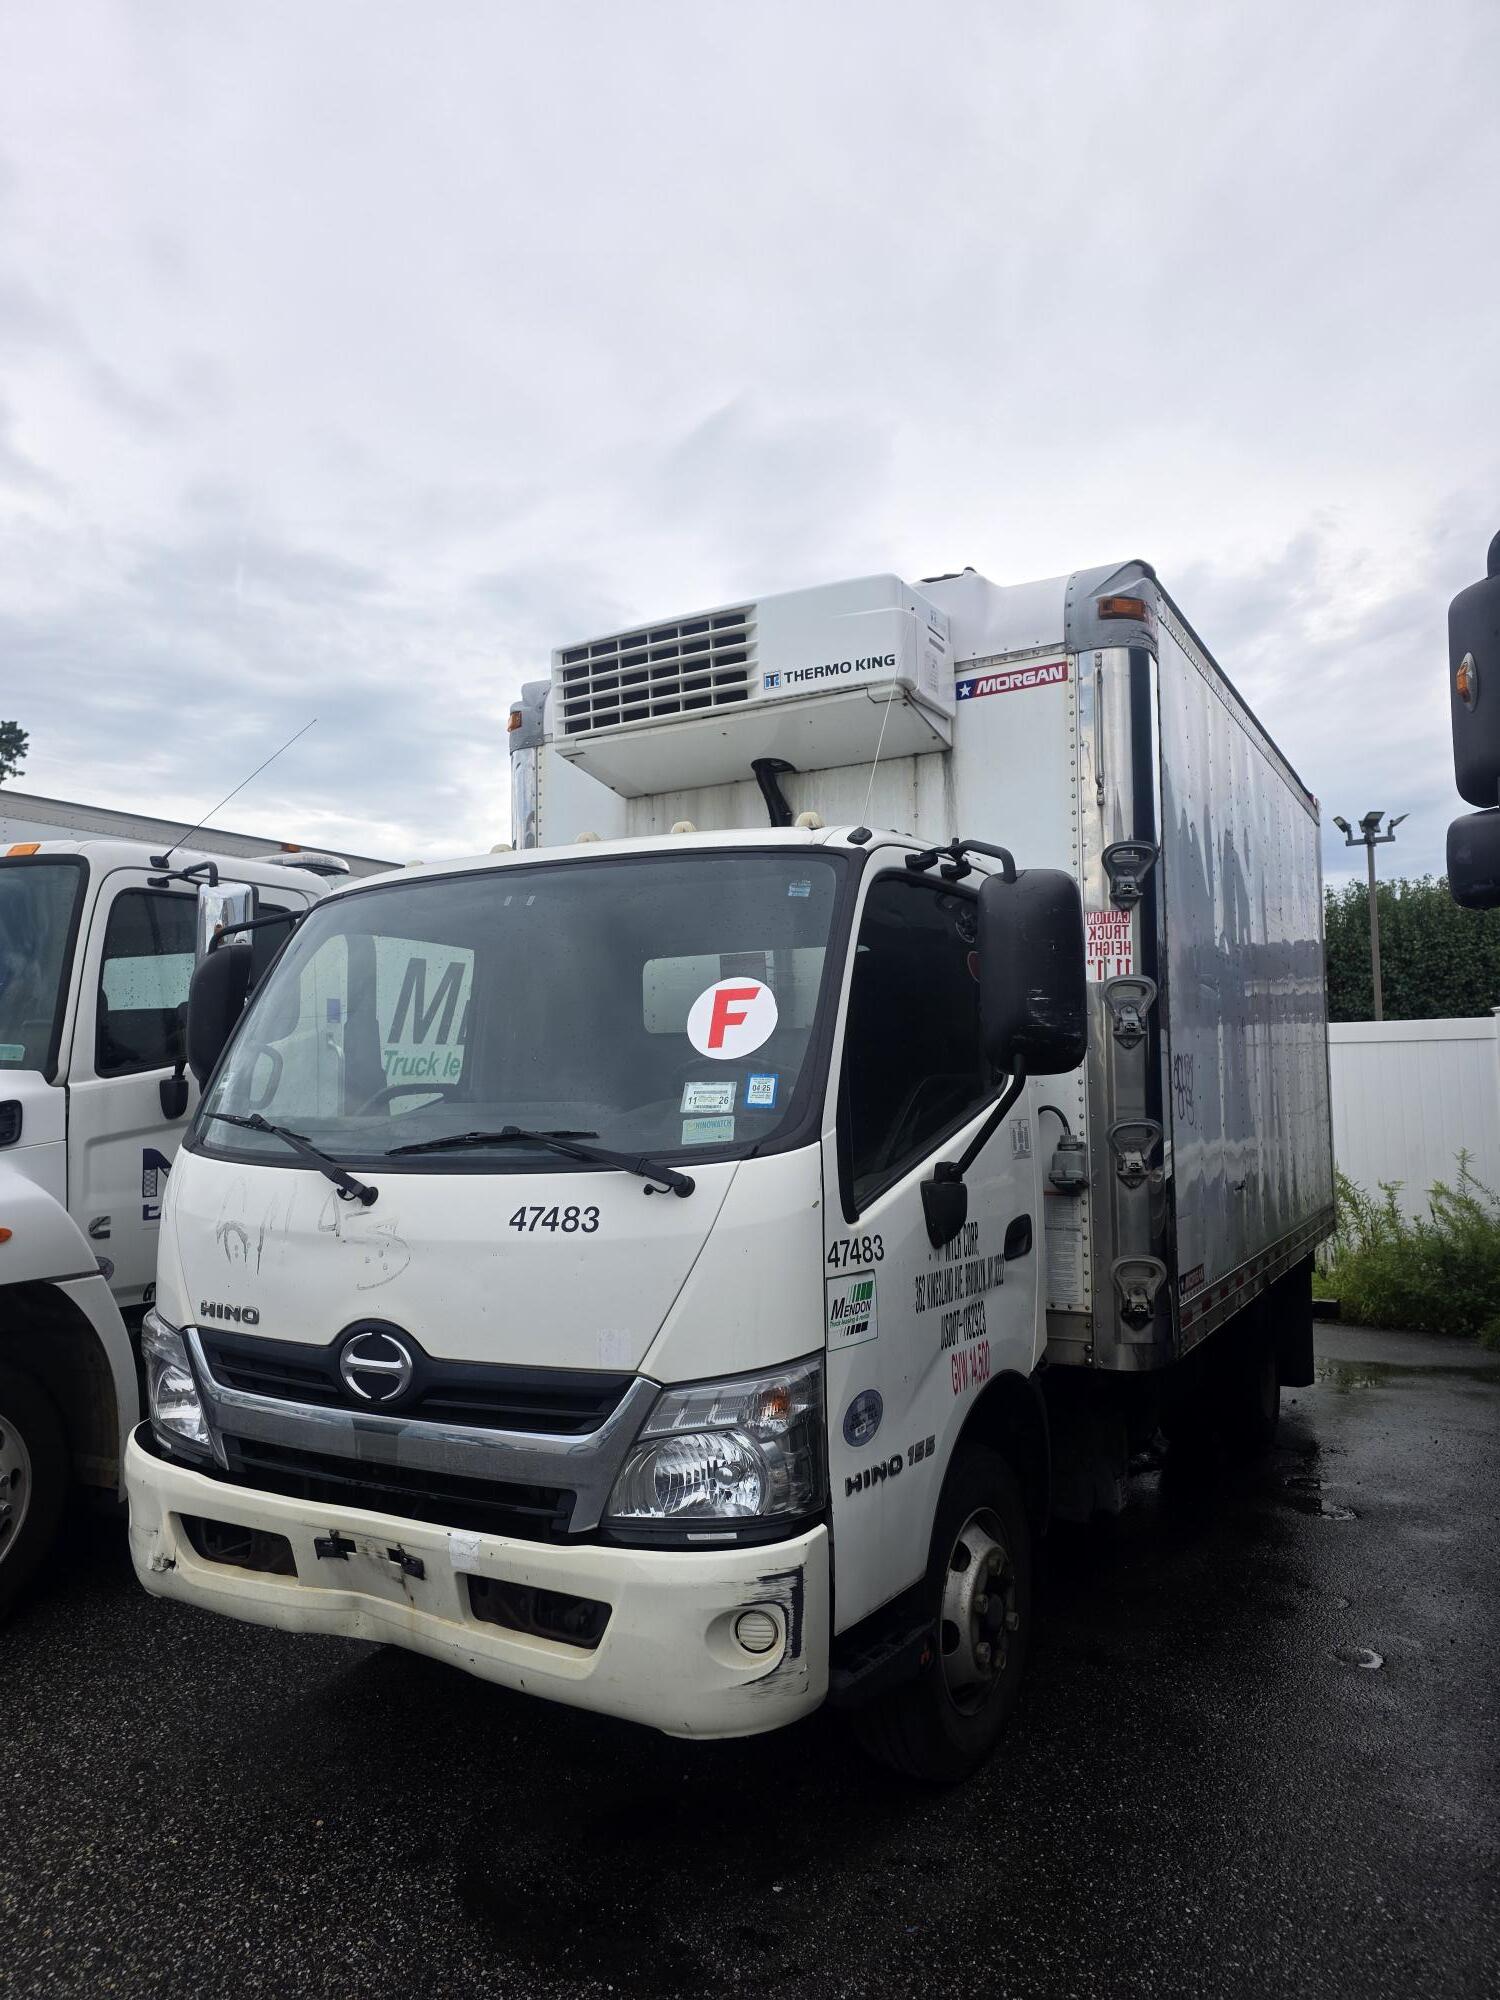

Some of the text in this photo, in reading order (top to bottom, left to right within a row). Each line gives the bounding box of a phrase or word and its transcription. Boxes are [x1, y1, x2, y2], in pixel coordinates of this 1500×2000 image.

[784, 654, 896, 683] THERMO KING
[976, 665, 1063, 694] MORGAN
[707, 986, 761, 1049] F
[384, 1050, 440, 1076] Truck
[718, 1096, 729, 1105] 26
[508, 1205, 600, 1233] 47483
[827, 1233, 885, 1268] 47483
[200, 1300, 260, 1325] HINO
[831, 1297, 872, 1320] MENDON
[844, 1454, 904, 1497] HINO
